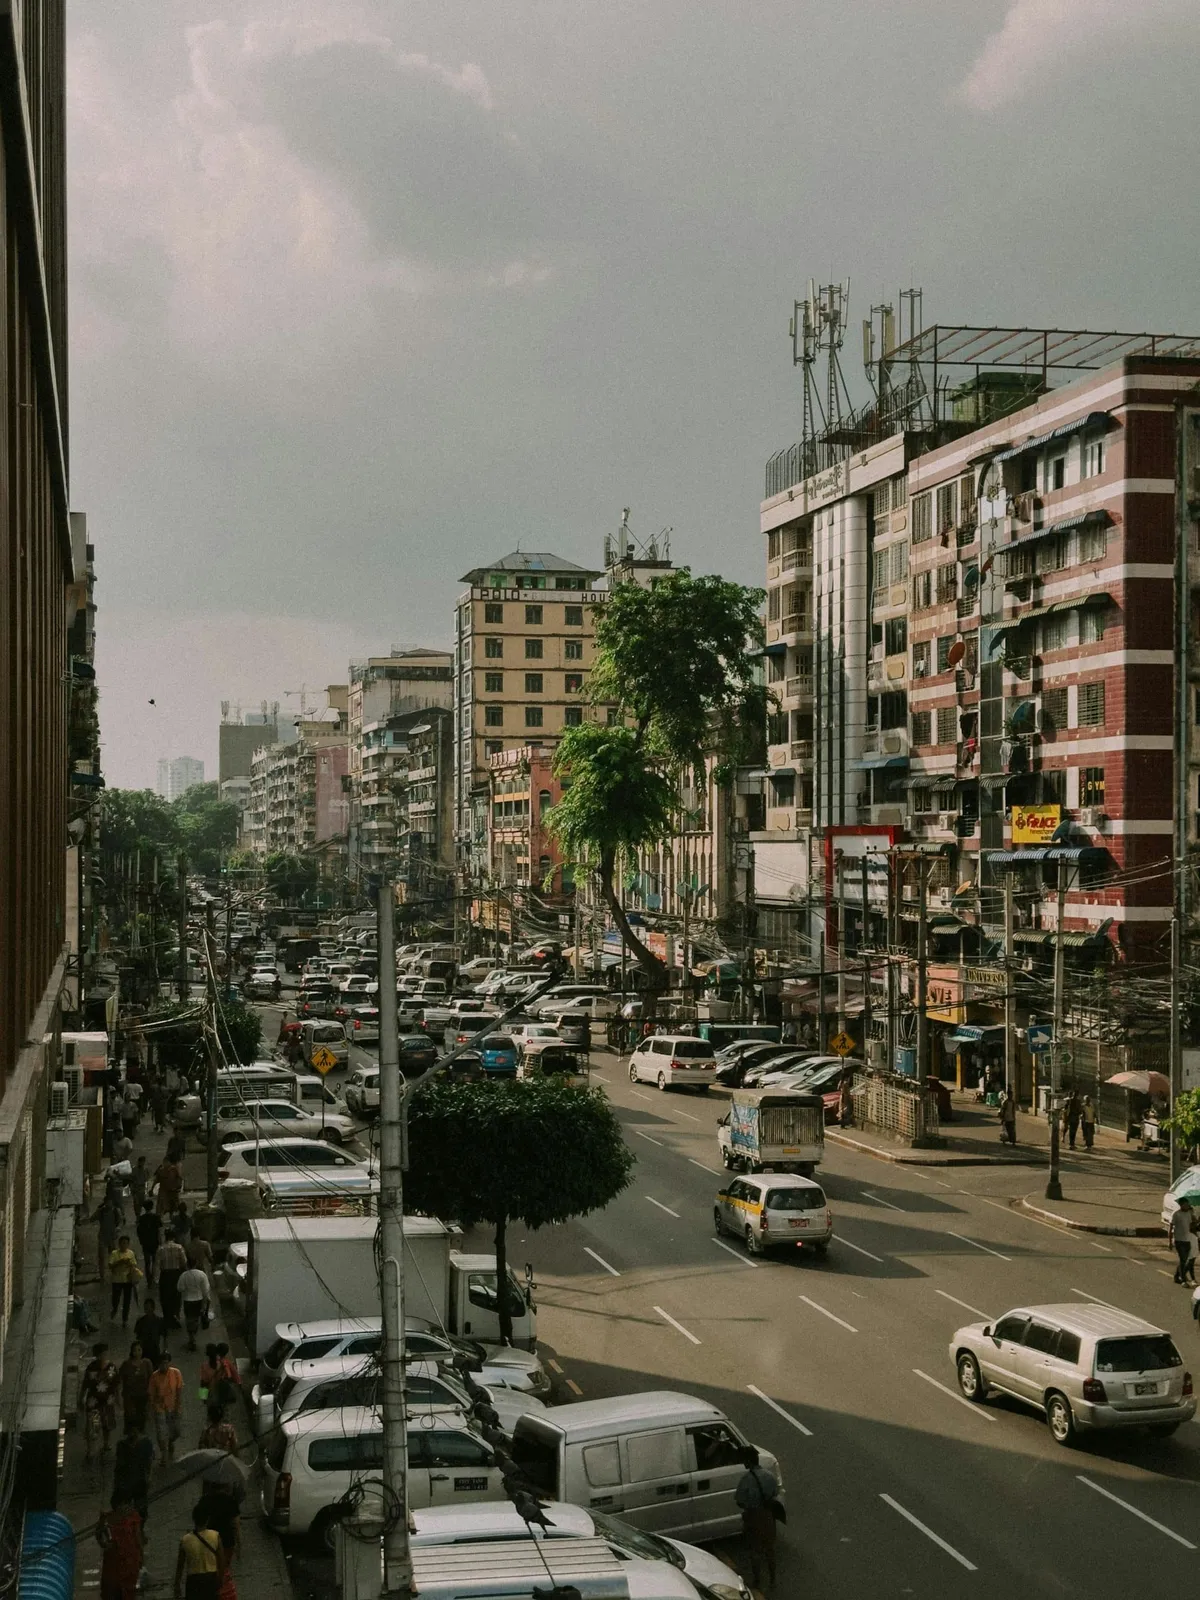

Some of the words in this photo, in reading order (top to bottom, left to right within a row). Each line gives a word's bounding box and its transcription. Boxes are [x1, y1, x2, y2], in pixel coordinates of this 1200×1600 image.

[481, 589, 519, 600] POLO
[582, 593, 614, 602] HOUS
[1087, 781, 1105, 791] GYM
[1027, 813, 1057, 828] GRACE
[967, 968, 1004, 984] UNIVERSA
